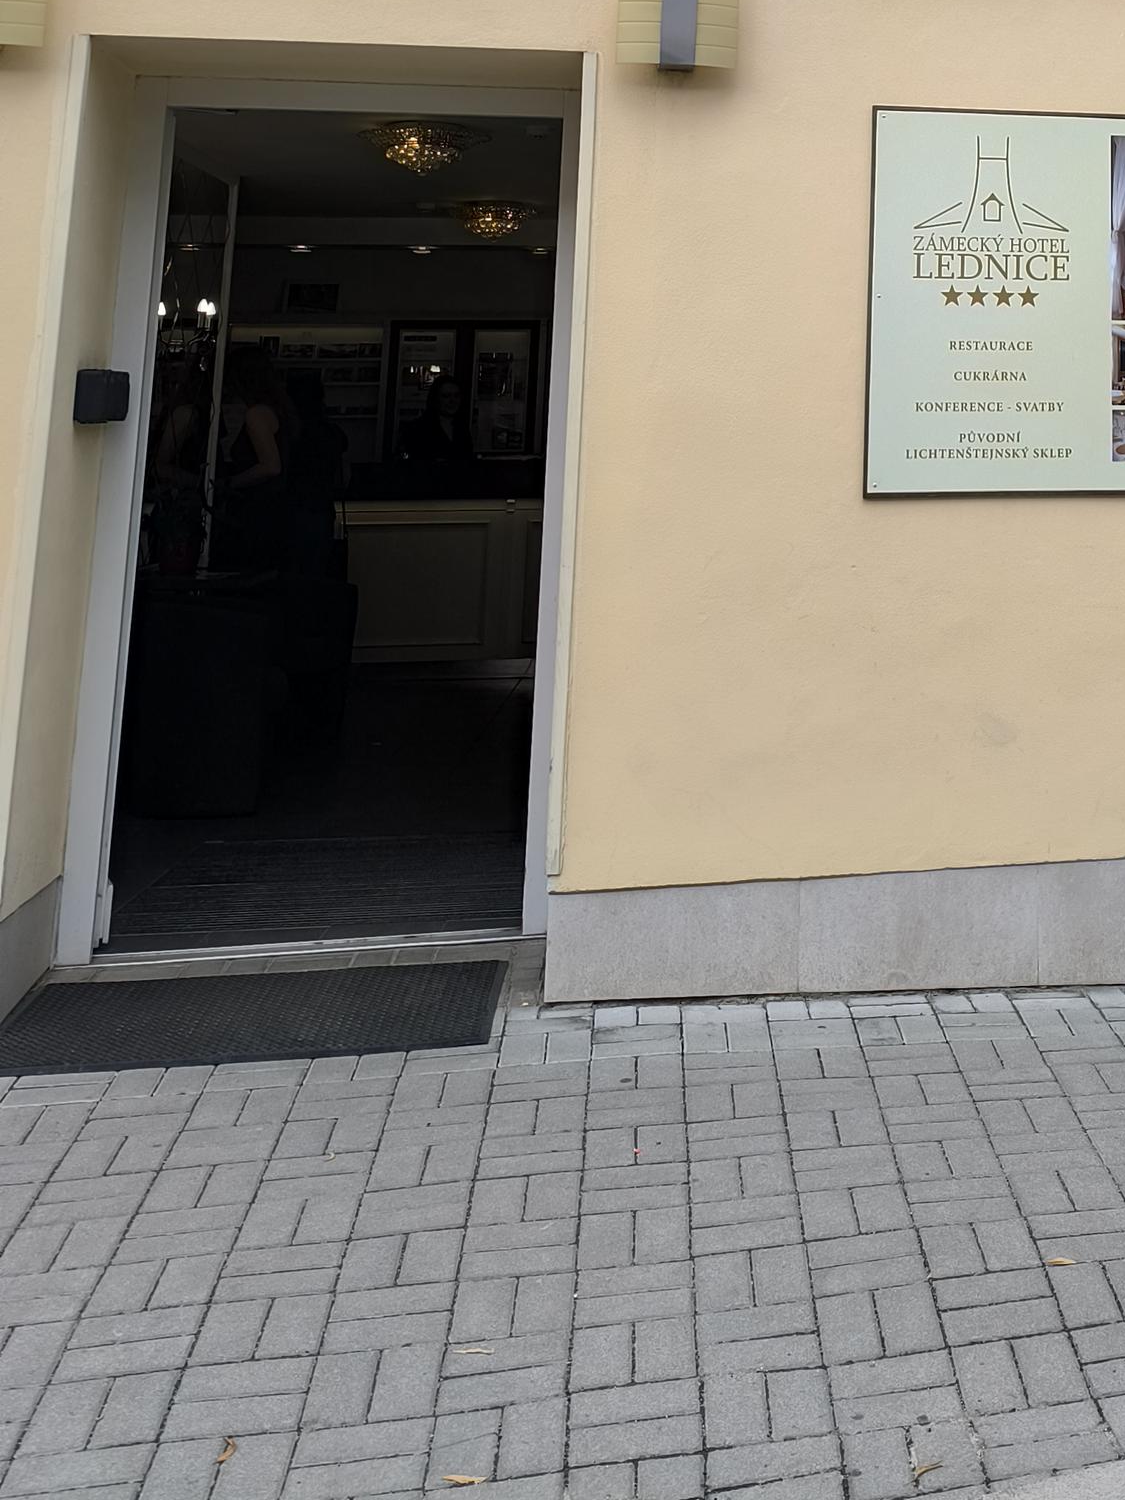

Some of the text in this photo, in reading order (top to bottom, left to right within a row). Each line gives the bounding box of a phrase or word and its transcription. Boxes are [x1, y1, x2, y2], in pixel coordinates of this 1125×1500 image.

[913, 232, 1070, 254] ZÁMECKÝ HOTEL
[912, 252, 1070, 281] LEDNICE
[949, 340, 1034, 351] RESTAURACE
[953, 369, 1028, 382] CUKRÁRNA
[915, 401, 1004, 413] KONFERENCE
[1015, 401, 1065, 413] SVATBY
[959, 430, 1021, 444] PŮVODNÍ
[905, 446, 1073, 460] LICHTENŠTEJNSKÝ SKLEP
